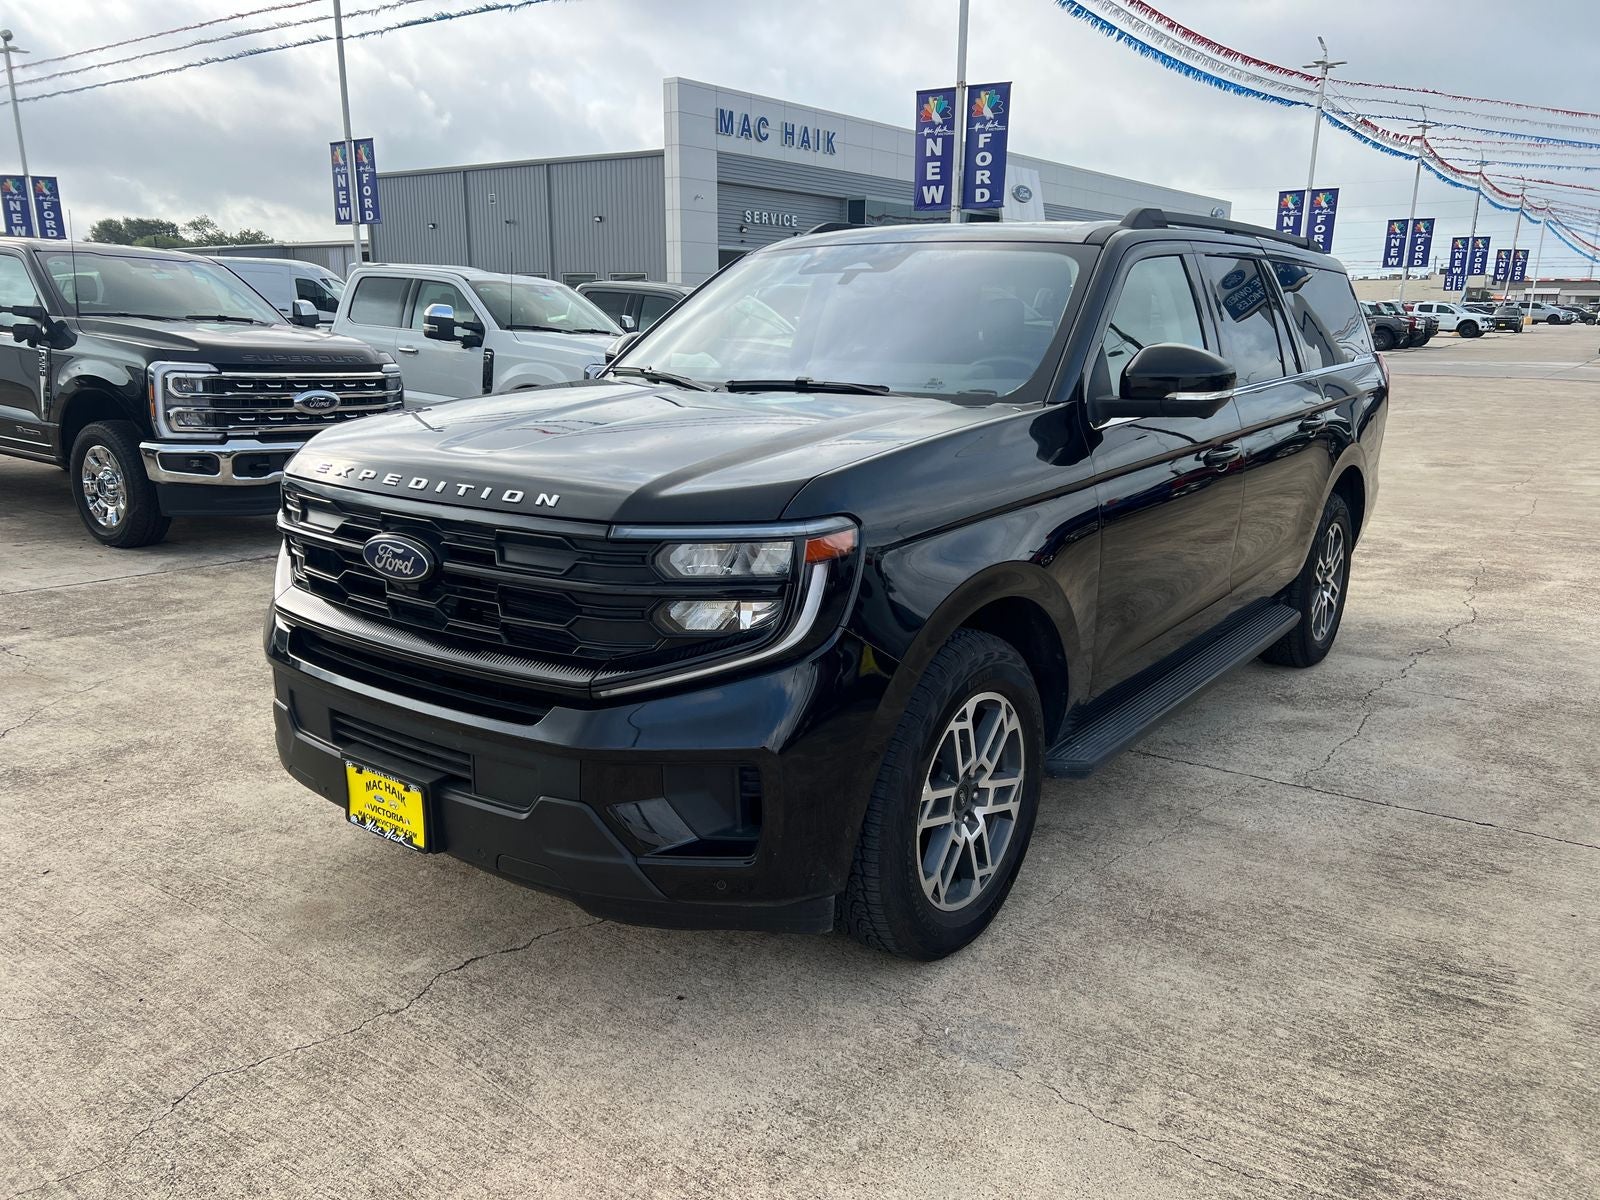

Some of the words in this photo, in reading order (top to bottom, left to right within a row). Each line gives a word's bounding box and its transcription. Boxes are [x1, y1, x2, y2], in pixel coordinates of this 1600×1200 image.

[718, 108, 769, 141] MAC
[784, 122, 836, 153] HAIK
[922, 137, 945, 204] NEW
[975, 133, 992, 203] FORD
[337, 174, 350, 220] NEW
[362, 173, 374, 221] FORD
[9, 200, 26, 236] NEW
[42, 201, 58, 237] FORD
[745, 210, 798, 227] SERVICE
[1313, 215, 1326, 249] FOR
[1387, 238, 1400, 266] NEW
[1413, 237, 1425, 266] FORD
[1452, 252, 1462, 274] NEW
[1473, 251, 1483, 274] FORD
[1496, 261, 1506, 280] NEW
[1514, 262, 1522, 281] FORD
[241, 354, 317, 362] SUPER
[319, 353, 365, 362] DUTY
[309, 397, 330, 407] Ford
[315, 463, 561, 508] EXPEDITION
[374, 543, 414, 576] Ford
[365, 780, 383, 792] MAC
[384, 782, 406, 806] HAIK
[370, 804, 404, 824] VICTORIA
[361, 819, 384, 837] Mac
[384, 829, 412, 847] Haik
